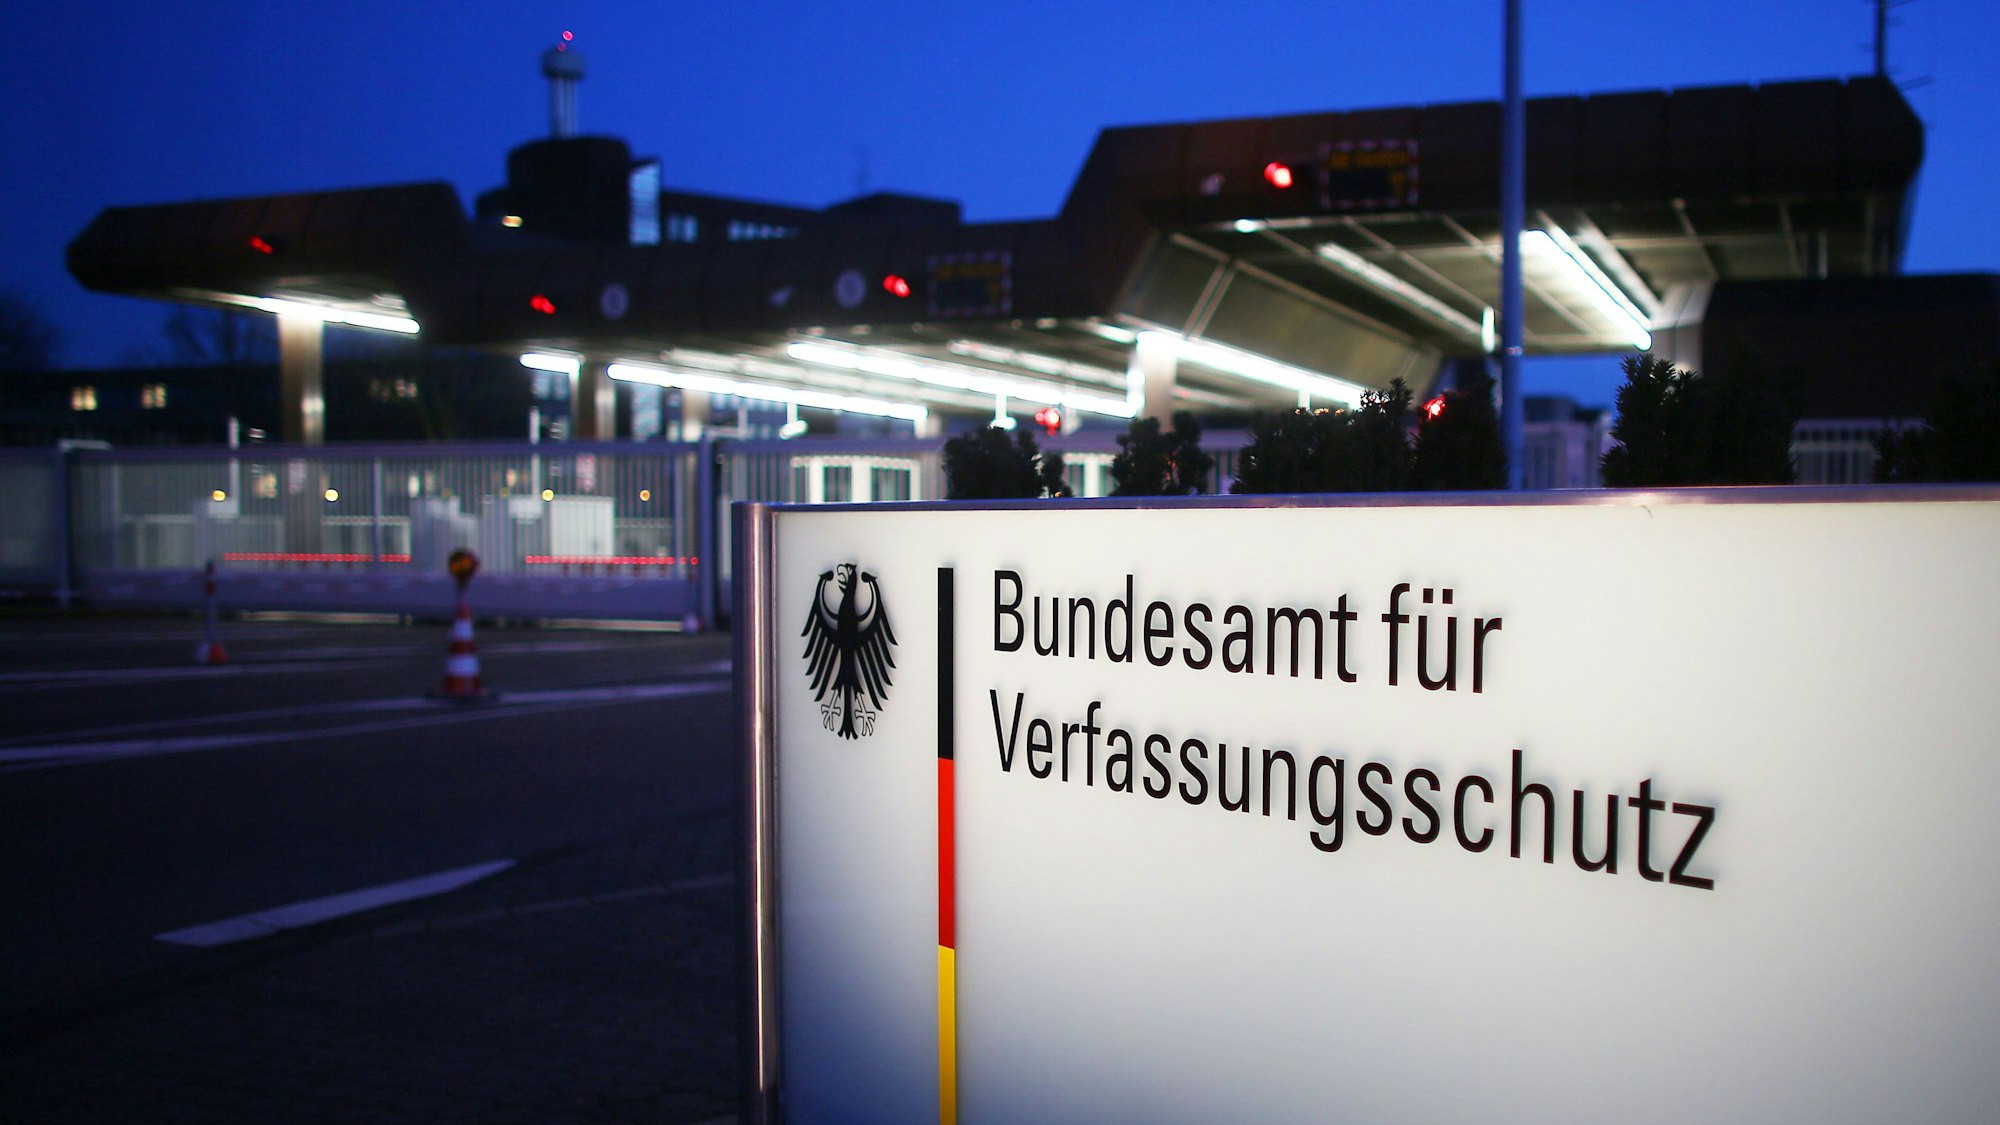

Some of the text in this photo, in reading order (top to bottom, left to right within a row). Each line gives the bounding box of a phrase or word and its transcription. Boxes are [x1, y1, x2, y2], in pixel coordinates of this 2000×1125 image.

[993, 569, 1503, 694] Bundesamt für
[989, 689, 1716, 891] Verfassungsschutz
